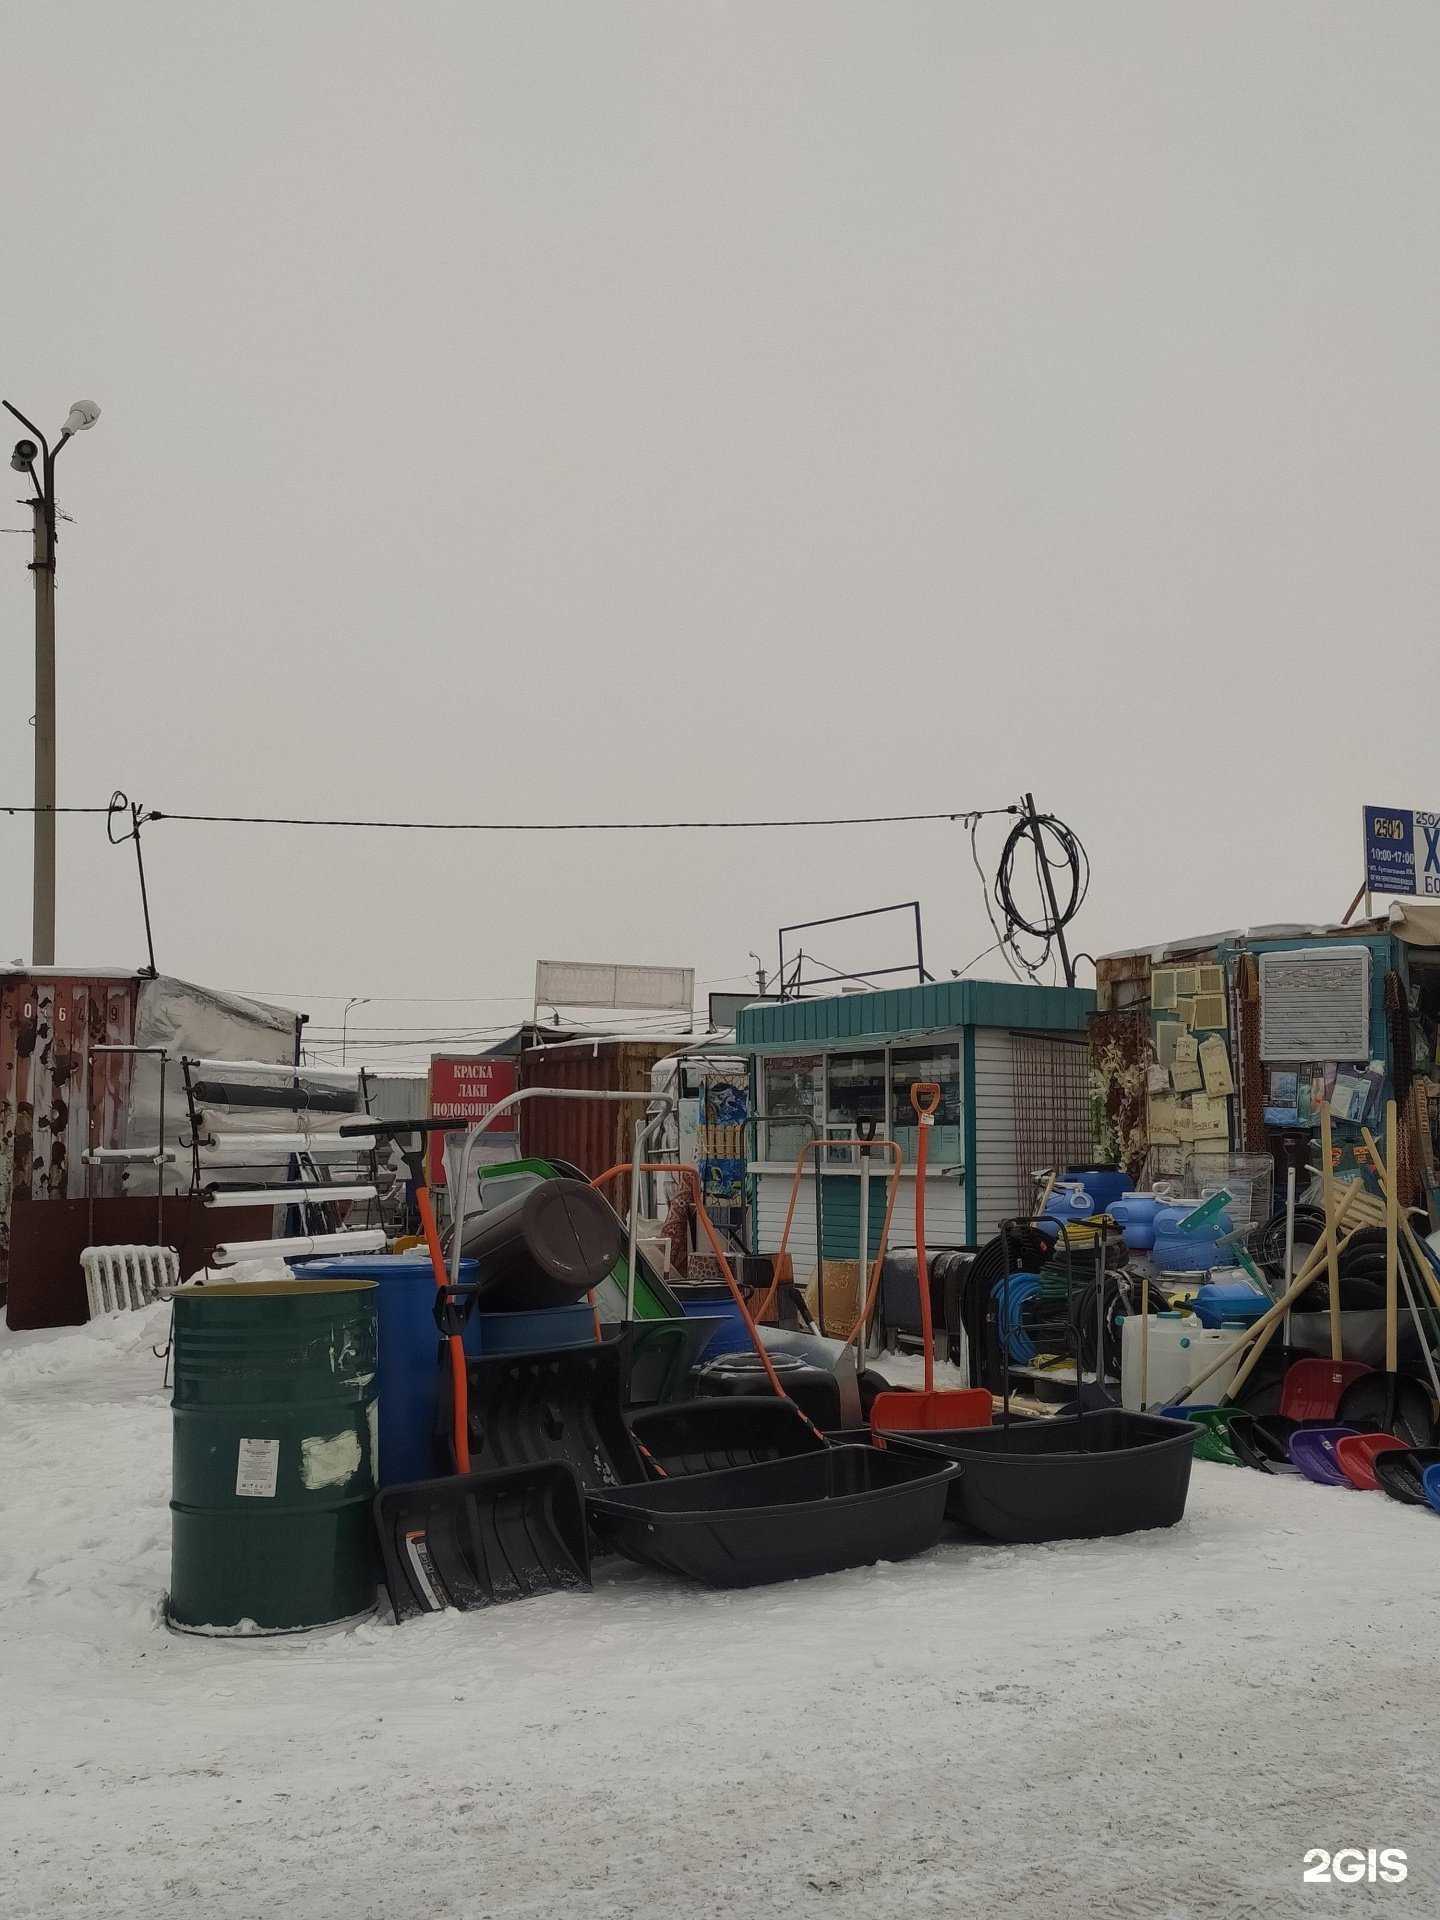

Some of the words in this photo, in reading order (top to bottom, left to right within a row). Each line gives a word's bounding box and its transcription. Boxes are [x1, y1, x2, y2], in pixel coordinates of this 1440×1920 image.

[1371, 848, 1415, 864] 10:00-17:00
[453, 1064, 493, 1079] КРАСКА
[458, 1084, 488, 1098] ЛАКИ
[432, 1102, 512, 1118] ПОДОКОННИ
